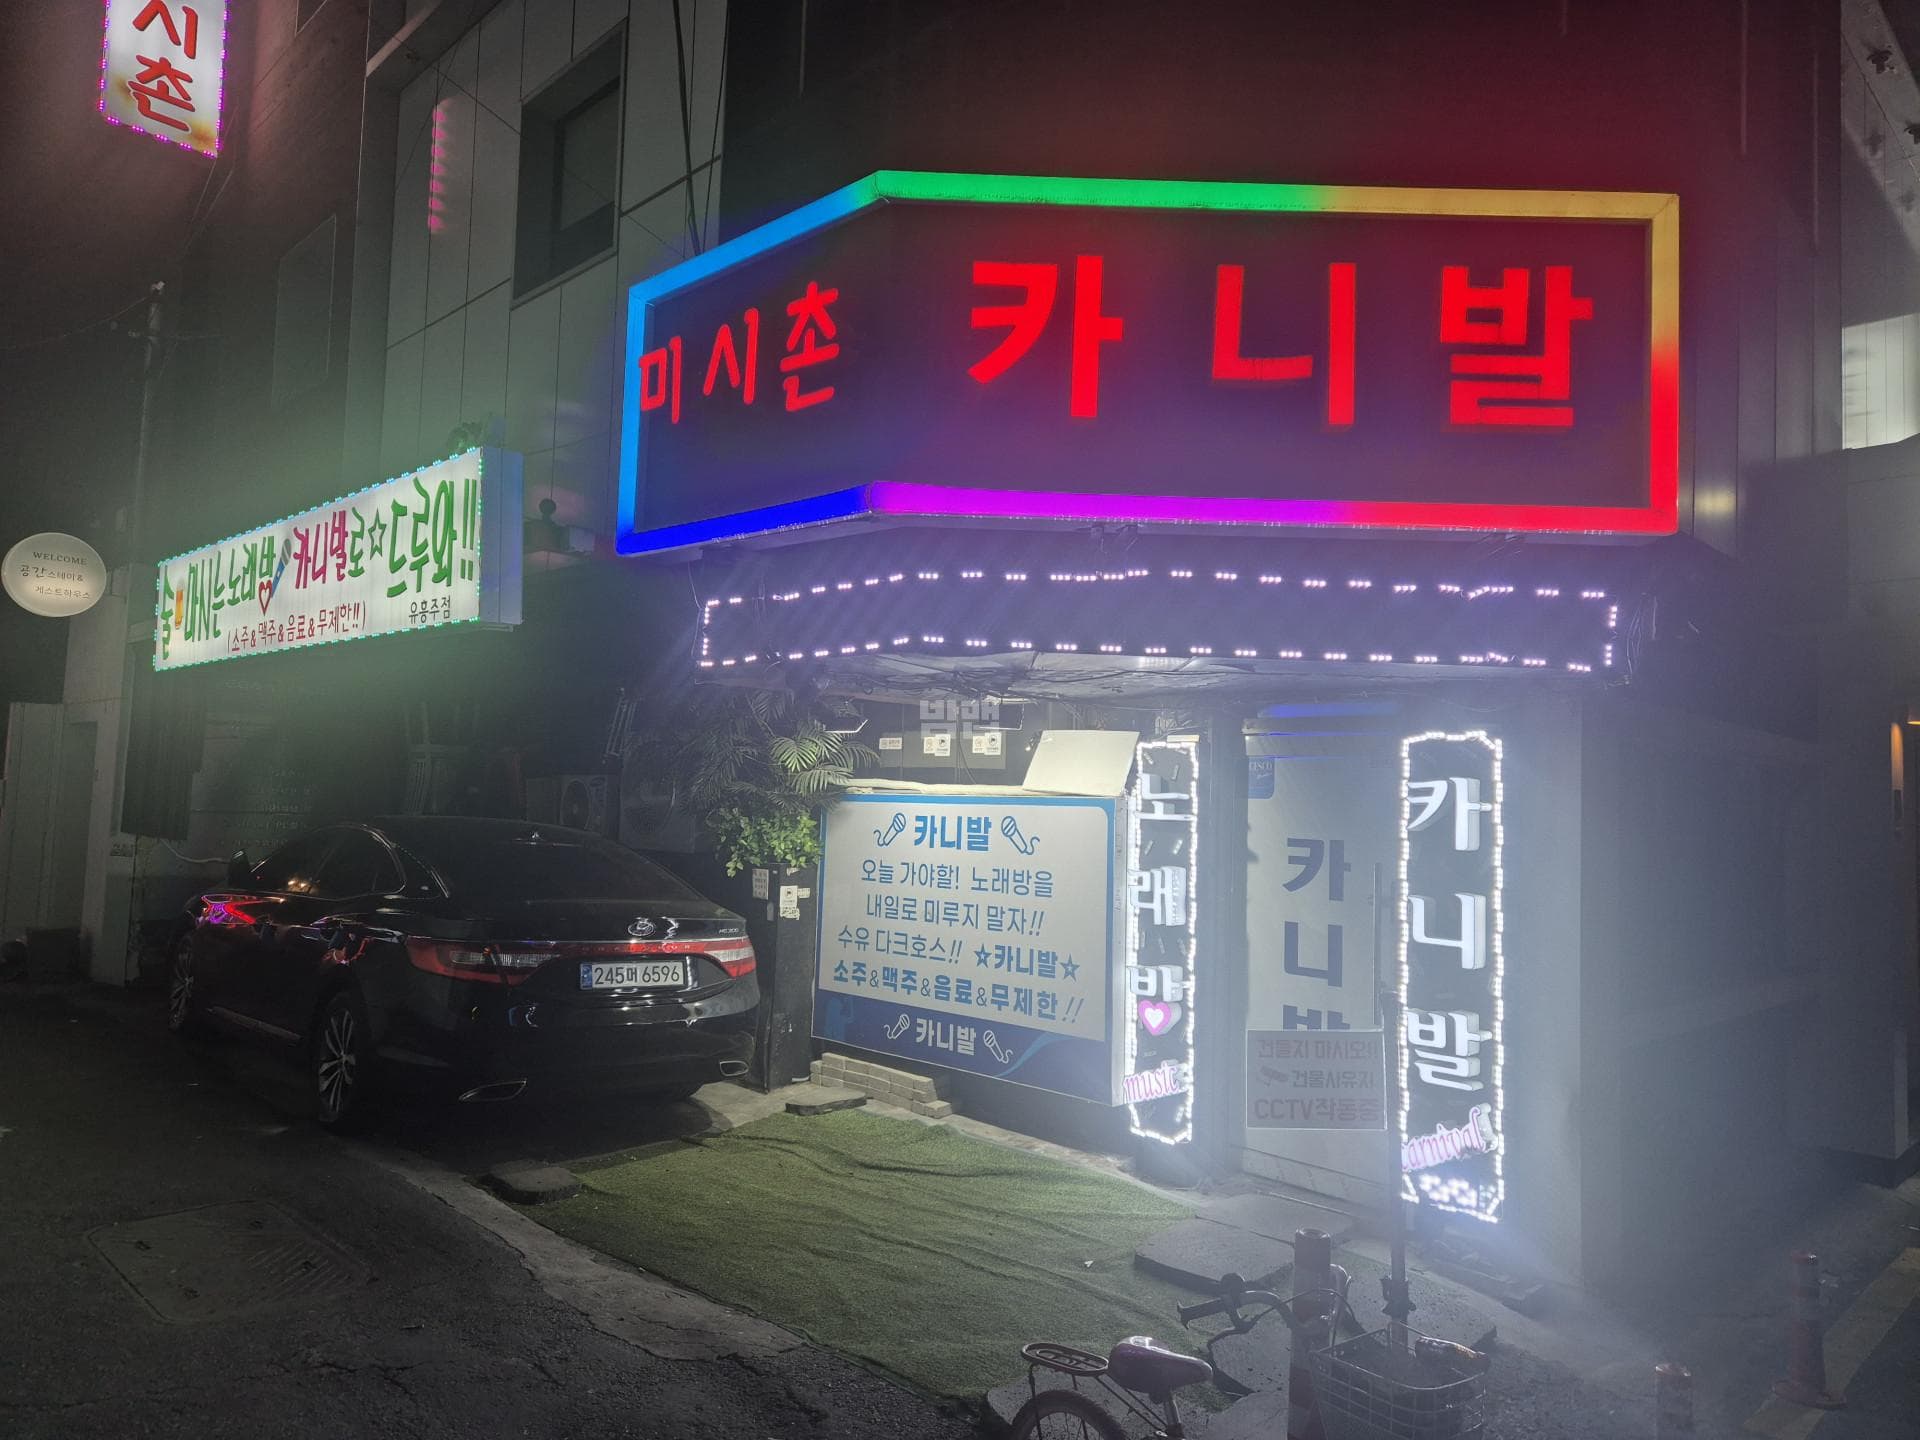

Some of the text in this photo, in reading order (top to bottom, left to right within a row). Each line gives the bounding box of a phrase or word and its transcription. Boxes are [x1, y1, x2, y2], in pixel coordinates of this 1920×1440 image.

[639, 255, 1593, 426] 미시촌 카니발
[33, 551, 87, 565] WELCOME
[35, 585, 90, 599] 게스트하우스
[408, 597, 451, 624] 유흥주점
[914, 815, 992, 851] 카니발
[861, 860, 1054, 898] 오늘 가야할! 노래방을
[866, 894, 1044, 936] 내일로 미루지 말자!!
[1407, 777, 1493, 1091] 카니발
[837, 924, 1058, 979] 수유 다크호스!! 카니발
[642, 965, 680, 982] 6596
[915, 1017, 976, 1056] 카니발
